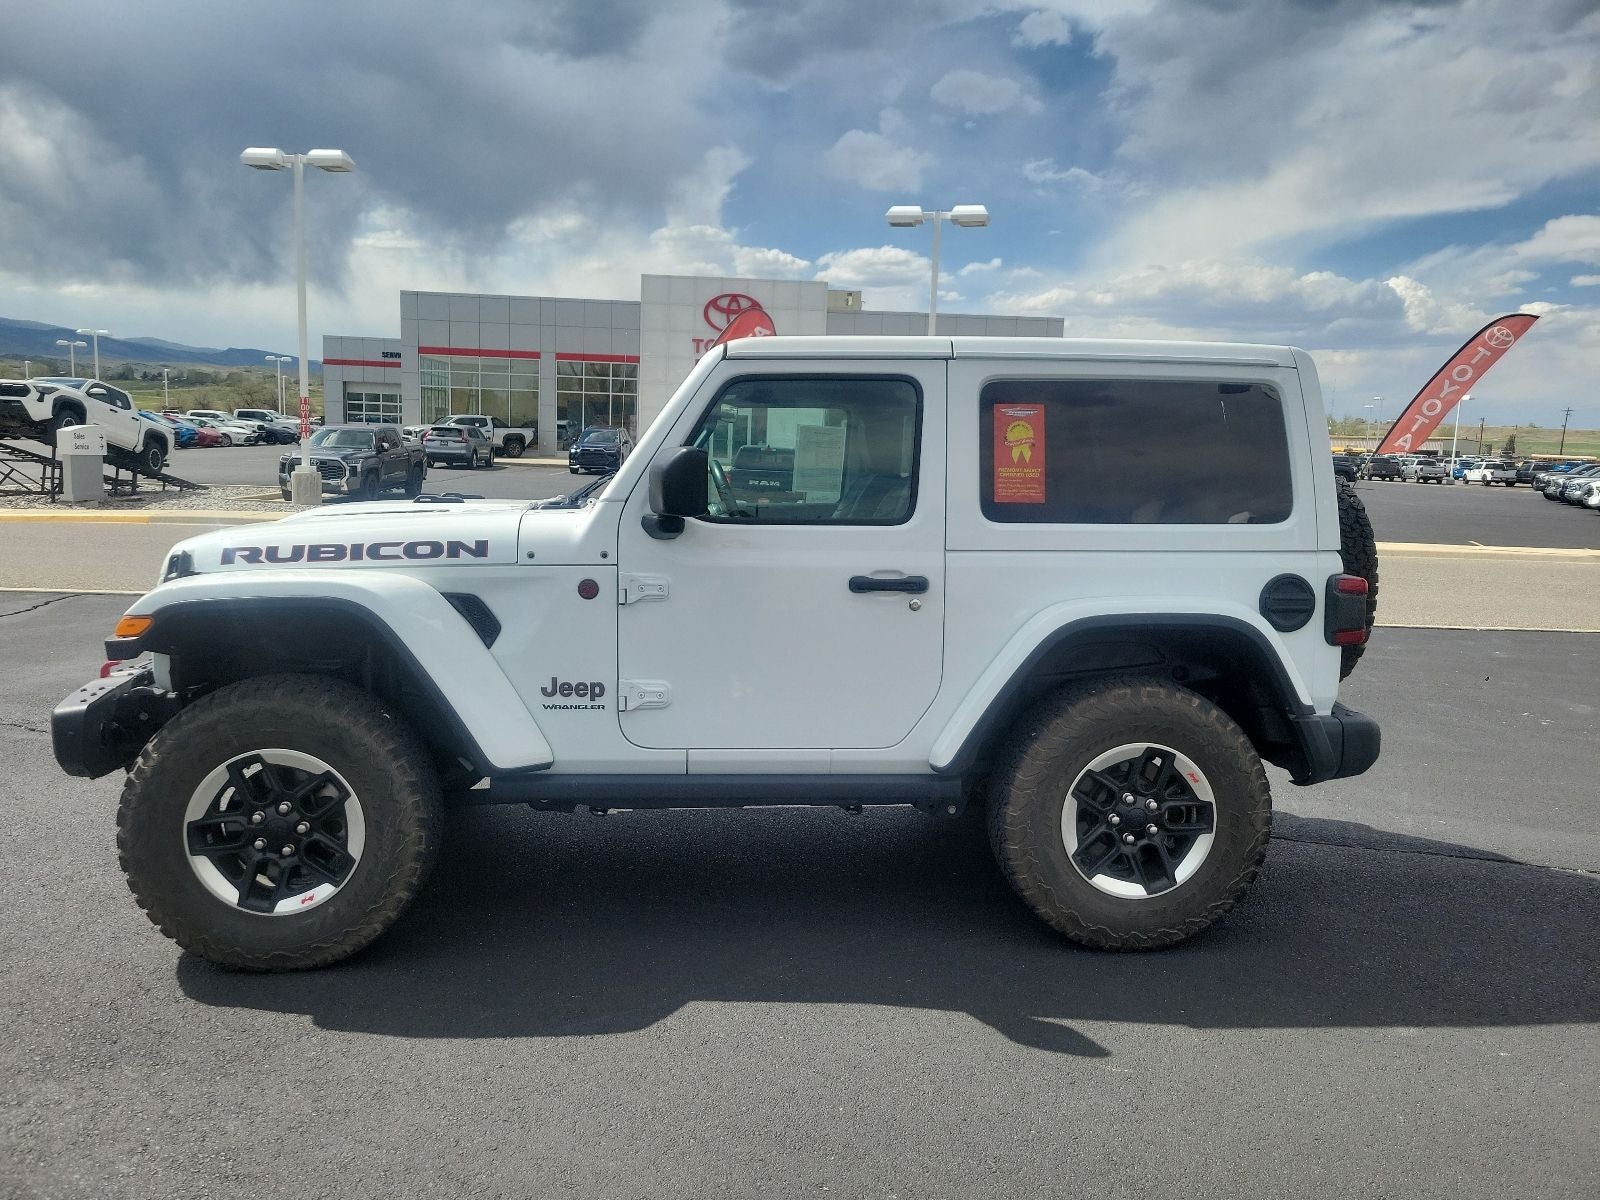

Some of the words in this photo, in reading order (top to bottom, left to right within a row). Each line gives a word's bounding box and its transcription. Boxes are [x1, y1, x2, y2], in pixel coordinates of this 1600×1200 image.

[1393, 346, 1491, 451] TOYOTA
[73, 432, 86, 440] Sales
[74, 442, 90, 450] Service
[220, 539, 489, 566] RUBICON
[540, 676, 606, 702] Jeep
[541, 703, 606, 711] WRANGLER
